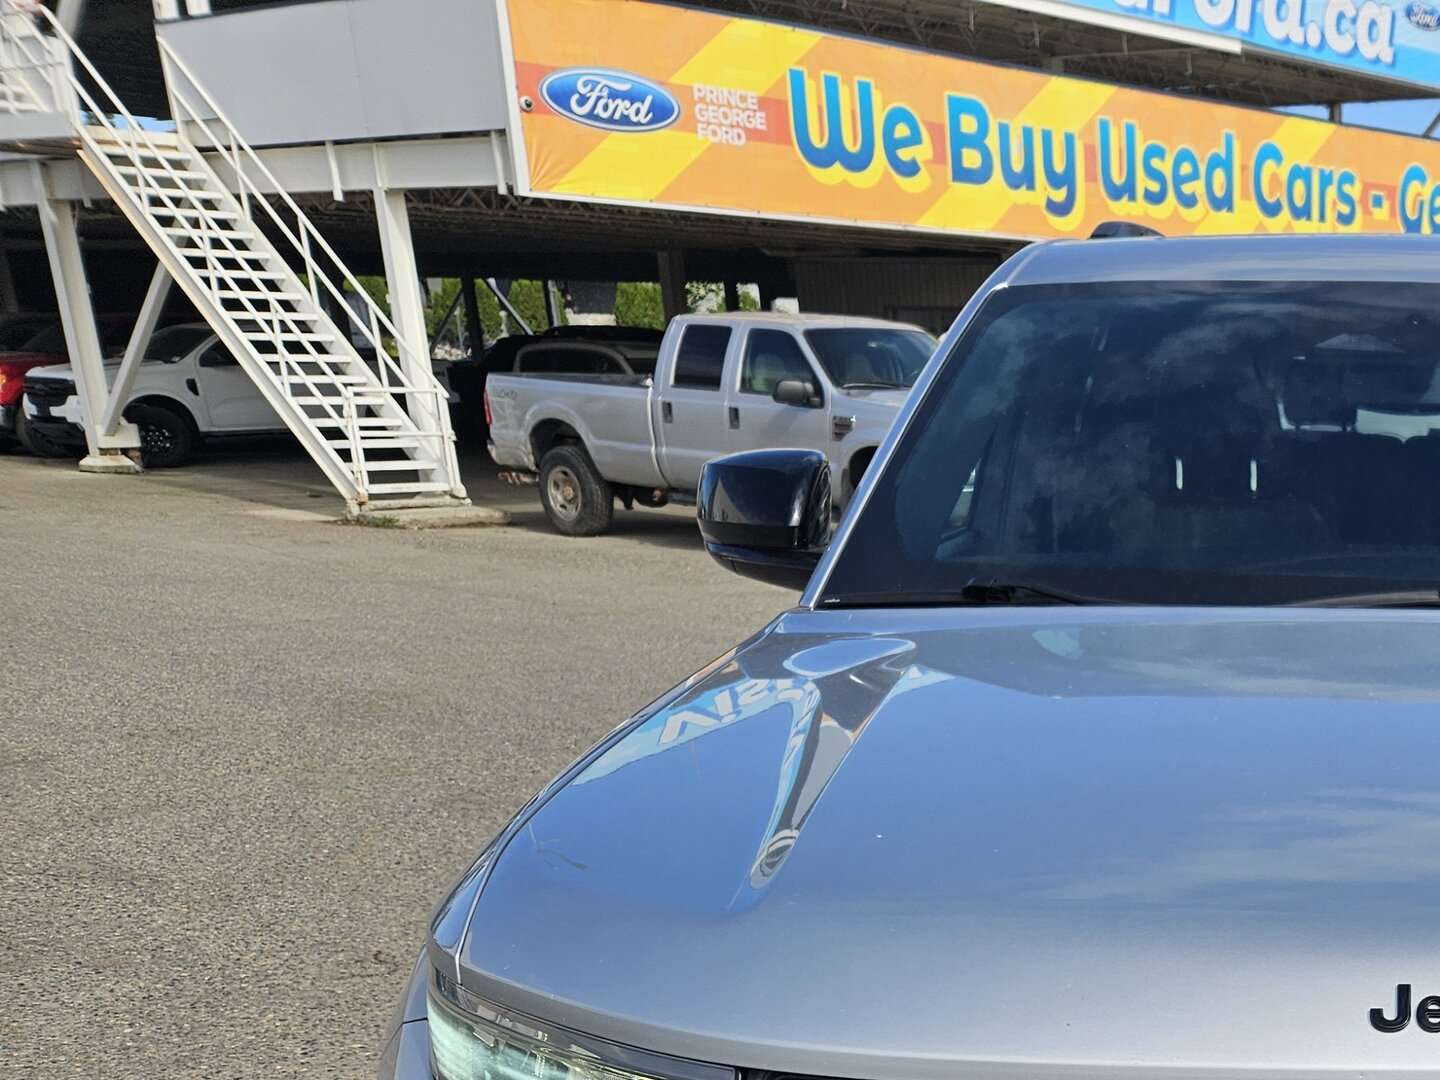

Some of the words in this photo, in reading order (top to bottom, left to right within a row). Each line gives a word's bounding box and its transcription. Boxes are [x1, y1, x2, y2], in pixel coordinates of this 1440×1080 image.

[569, 75, 654, 125] Ford
[692, 83, 759, 110] PRINCE
[694, 103, 768, 131] GEORGE
[696, 123, 747, 147] FORD
[788, 68, 924, 179] We
[947, 93, 1077, 217] Buy
[1098, 117, 1234, 214] Used
[1253, 142, 1358, 226] Cars
